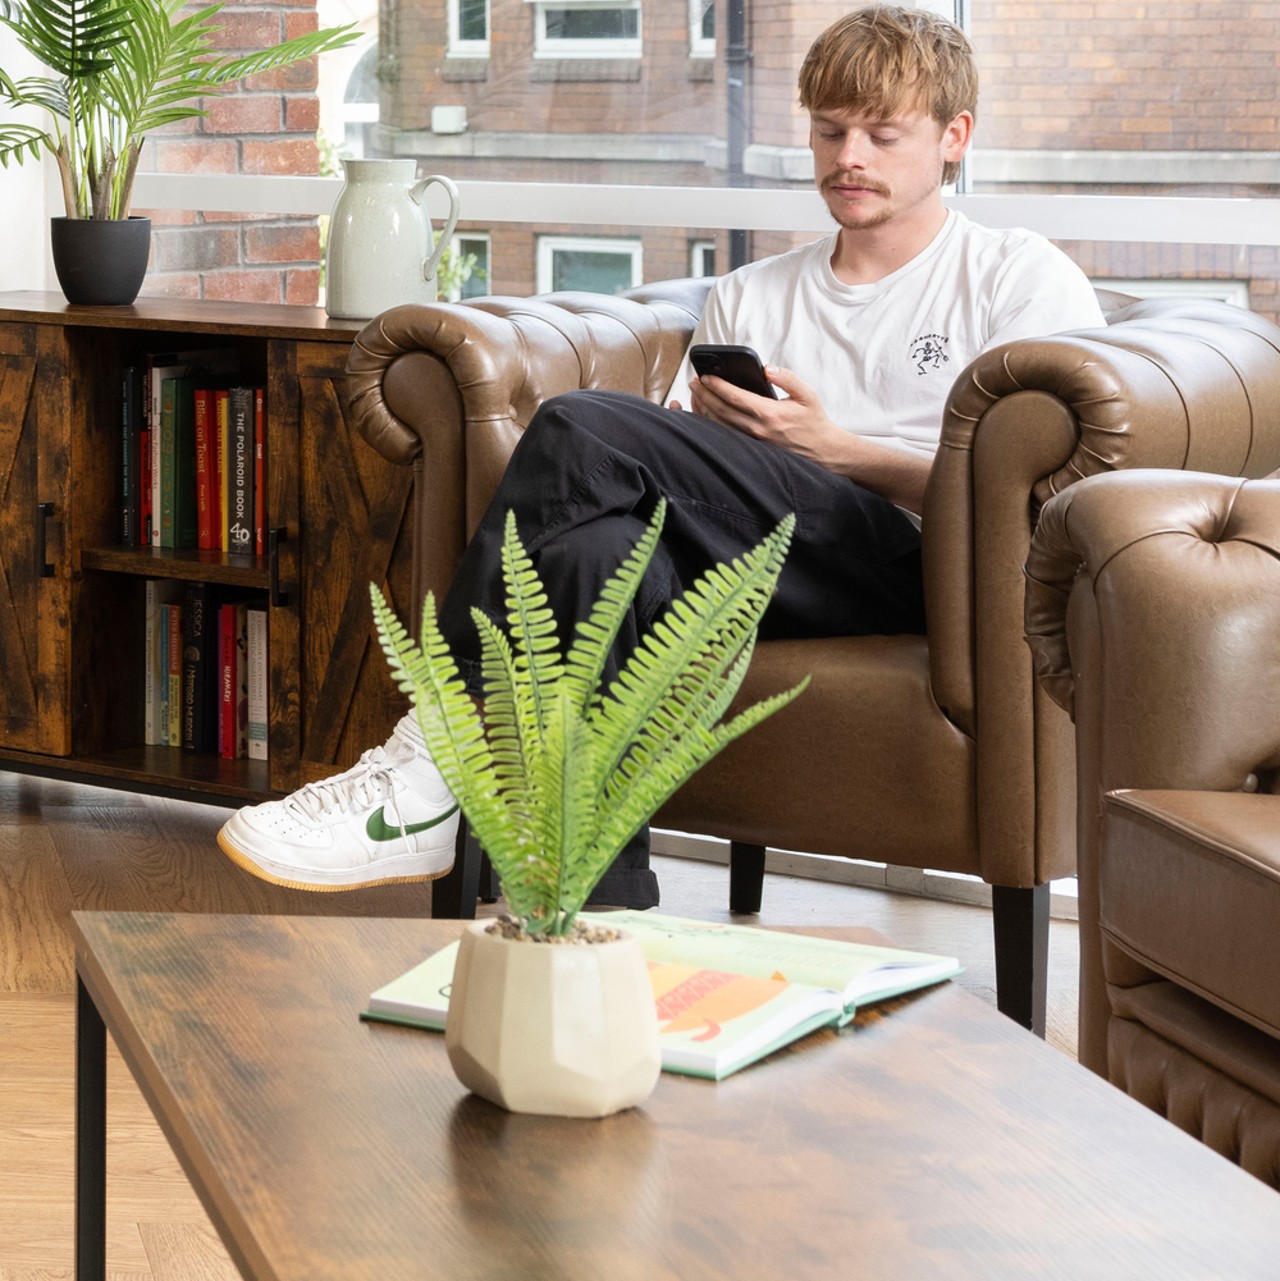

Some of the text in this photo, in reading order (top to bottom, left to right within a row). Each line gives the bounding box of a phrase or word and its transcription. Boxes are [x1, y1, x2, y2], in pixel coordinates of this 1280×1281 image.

[196, 399, 207, 474] Bliss on Toast
[236, 412, 245, 432] THE
[236, 435, 245, 487] POLAROID
[236, 490, 245, 519] BOOK
[230, 522, 250, 542] 40
[193, 597, 202, 637] JESSICA
